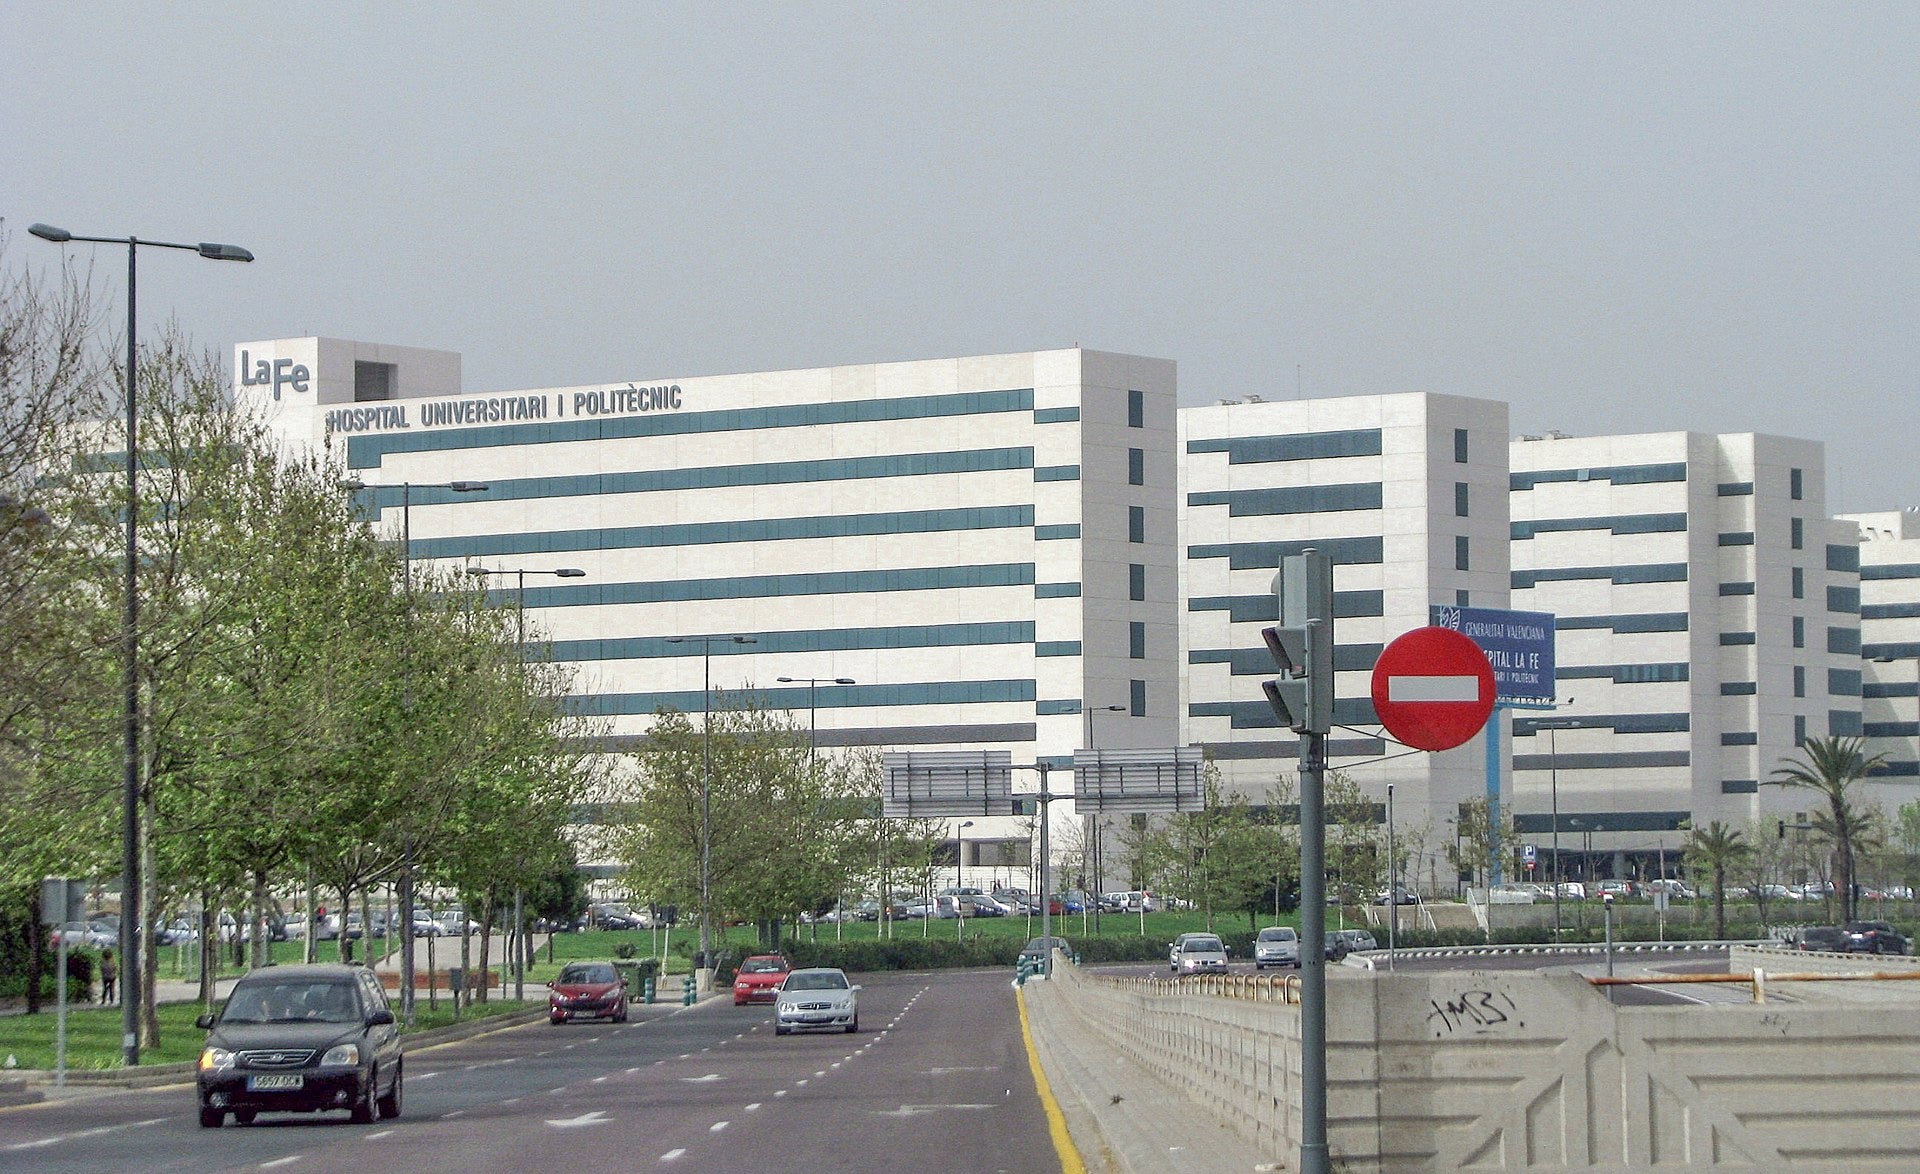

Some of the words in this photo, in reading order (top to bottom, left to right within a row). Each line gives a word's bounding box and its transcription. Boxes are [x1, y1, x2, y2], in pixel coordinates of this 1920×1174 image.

[327, 405, 410, 433] HOSPITAL
[420, 394, 547, 427] UNIVERSITARI
[557, 394, 563, 417] I
[573, 383, 682, 416] POLITÈCNIC
[1465, 622, 1504, 638] GENERALITAT
[1506, 623, 1545, 640] VALENCIANA
[1515, 652, 1525, 669] LA
[1530, 653, 1540, 670] FE
